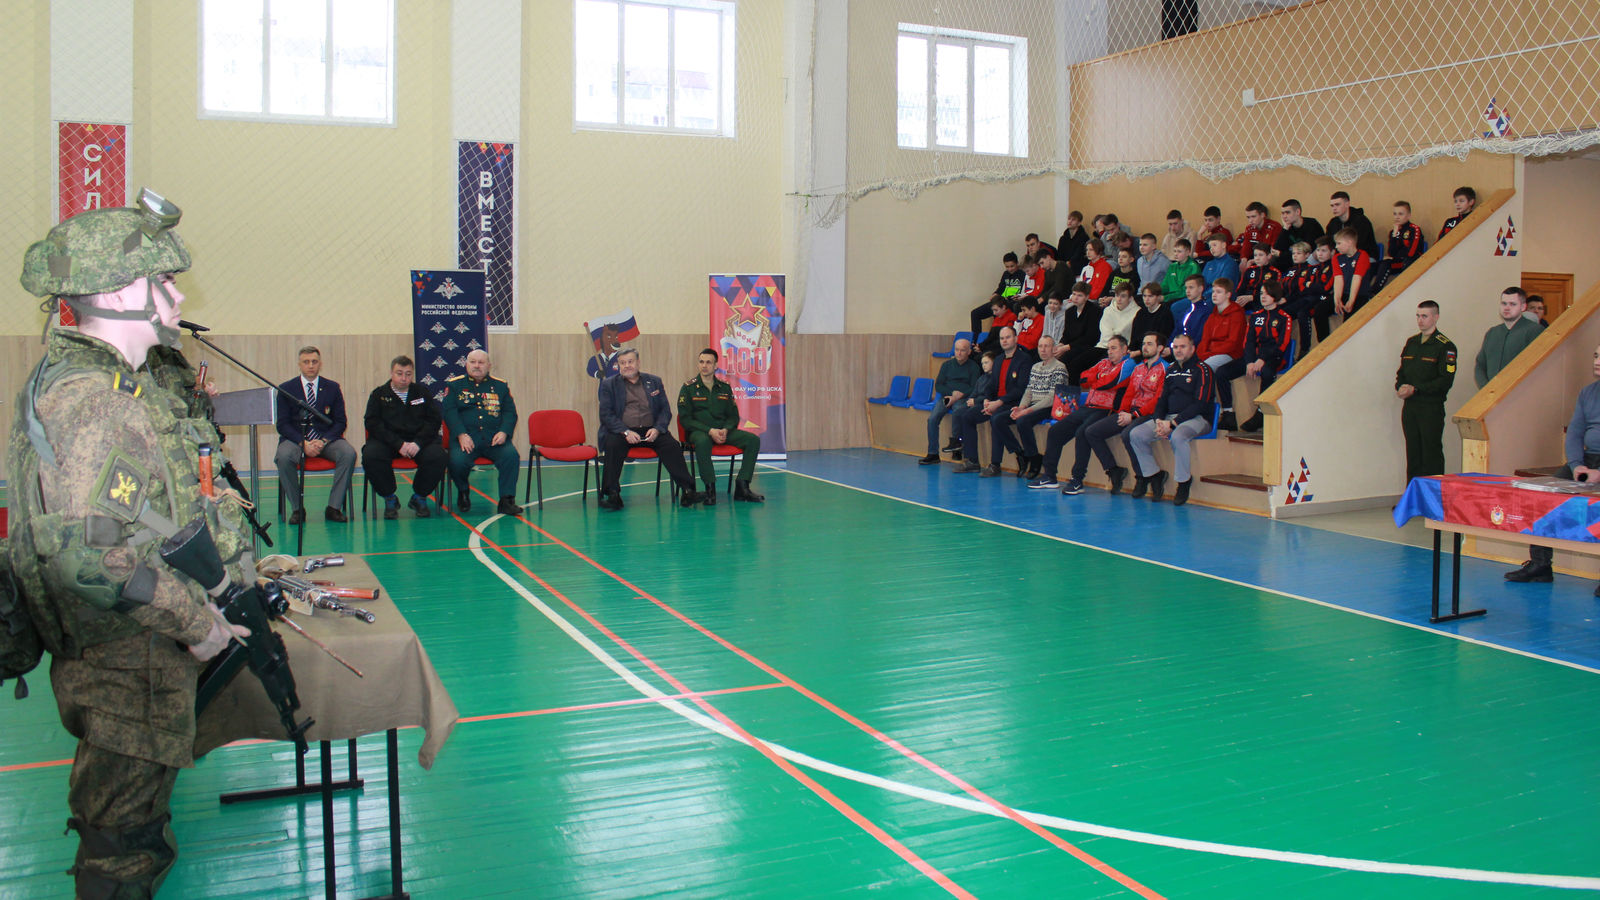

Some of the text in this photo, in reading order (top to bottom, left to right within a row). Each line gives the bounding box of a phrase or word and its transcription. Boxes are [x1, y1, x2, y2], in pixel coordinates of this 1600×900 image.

[83, 144, 102, 210] СИЛ
[478, 171, 495, 298] ВМЕСТЕ
[1254, 317, 1265, 326] 23
[736, 331, 756, 346] ЦСКА
[726, 346, 768, 375] 100
